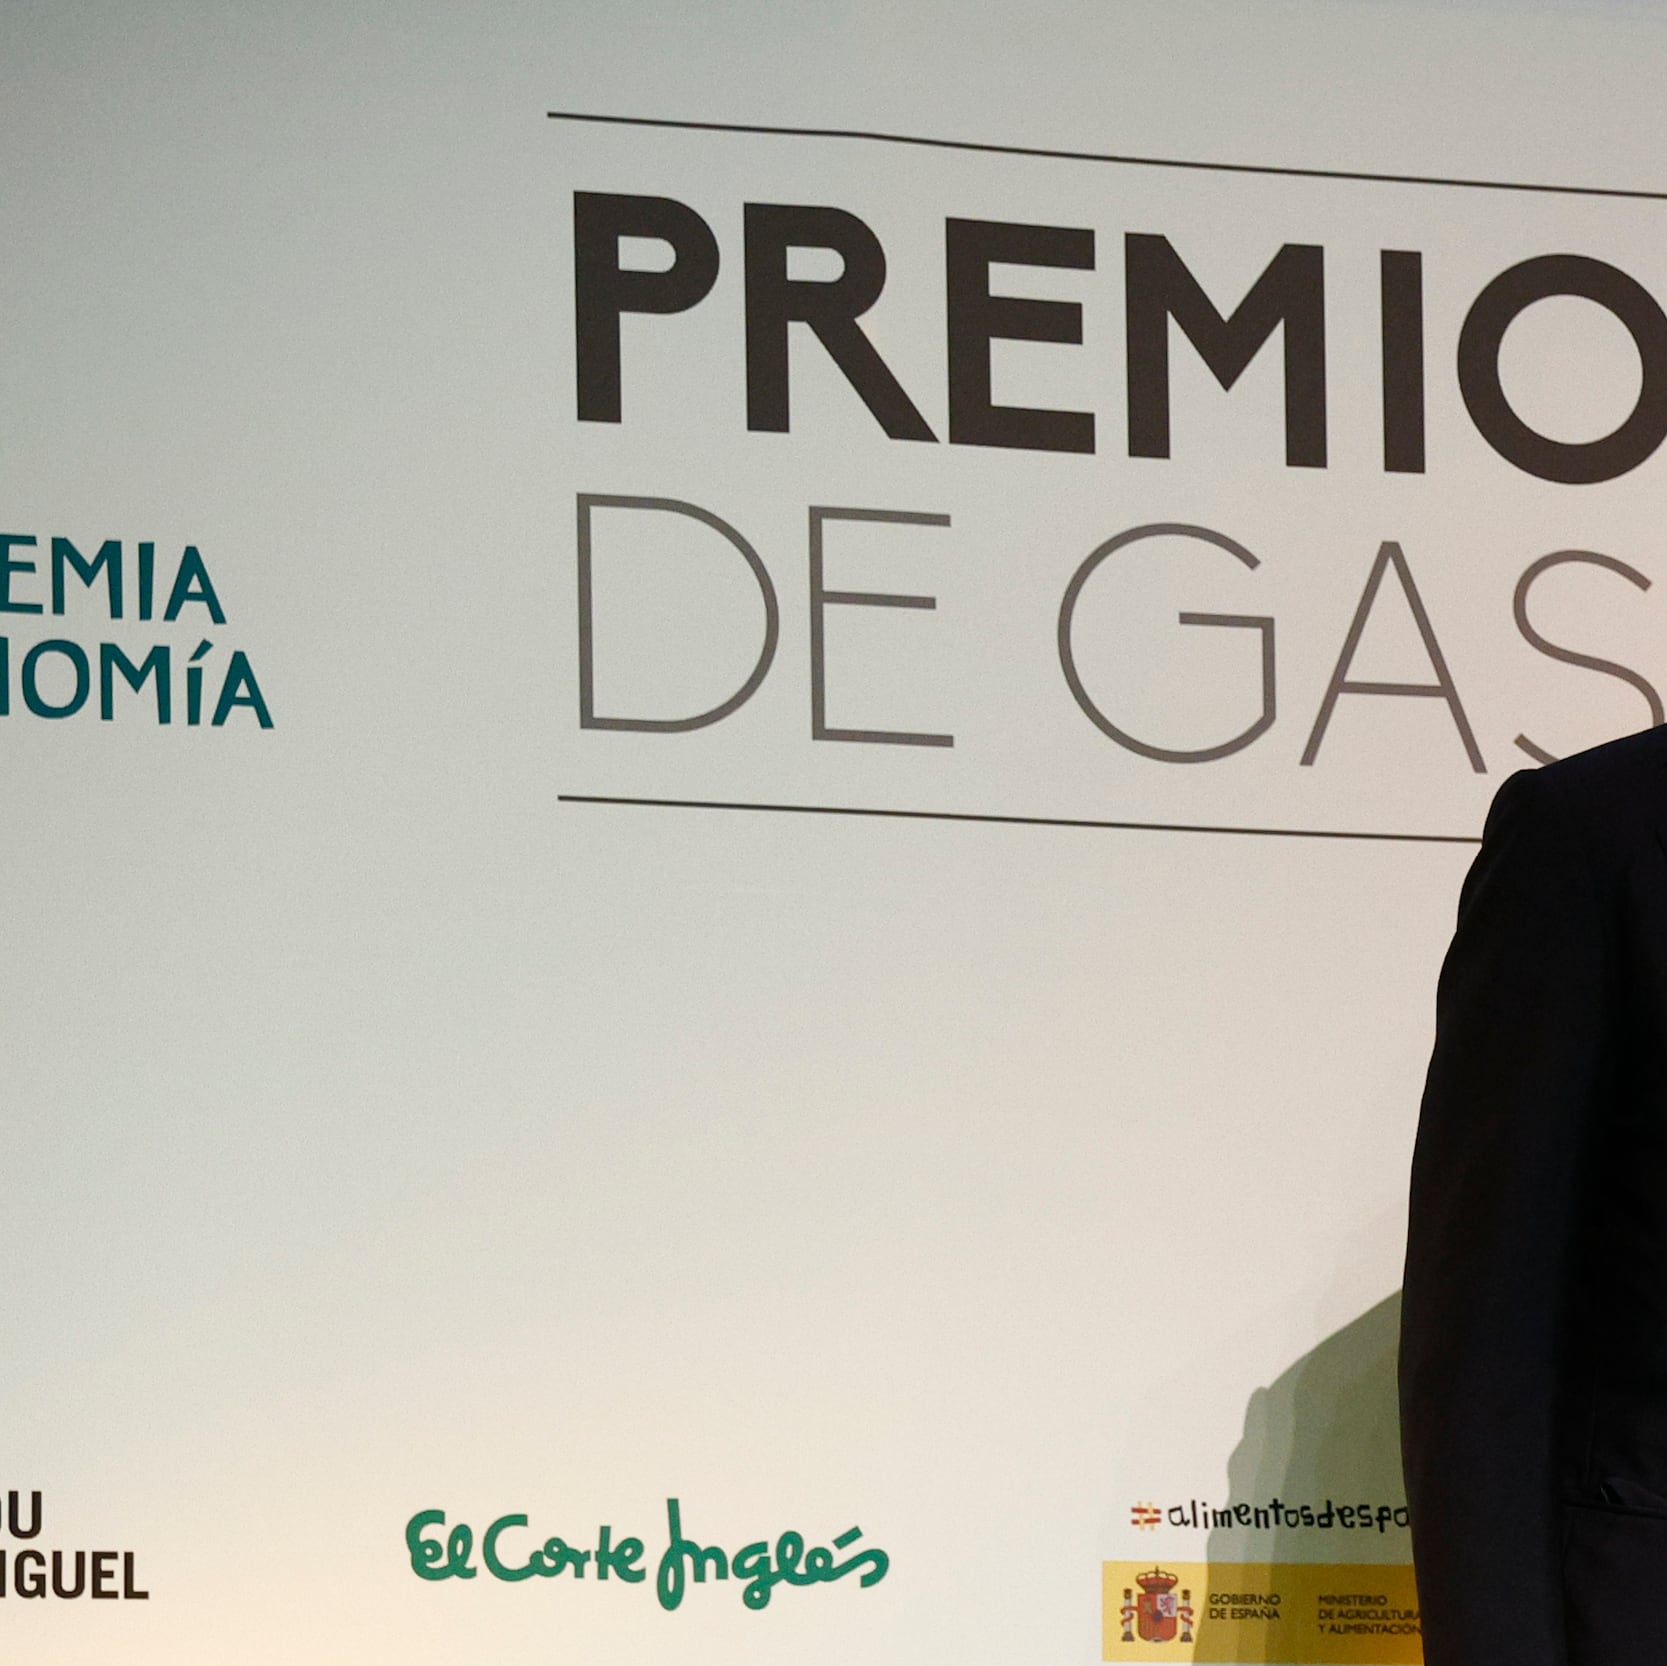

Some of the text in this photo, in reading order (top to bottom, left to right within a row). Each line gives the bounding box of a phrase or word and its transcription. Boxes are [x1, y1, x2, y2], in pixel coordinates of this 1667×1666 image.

[0, 533, 227, 624] EMIA
[576, 493, 954, 748] DE
[1131, 1498, 1411, 1532] #alimentosdespa
[405, 1498, 890, 1611] El Corte Inglés
[0, 1549, 149, 1600] IGUEL
[1208, 1593, 1282, 1606] GOBIERNO
[1318, 1595, 1388, 1606] MINISTERIO
[1209, 1605, 1281, 1619] DE ESPAÑA
[1318, 1609, 1334, 1620] DE
[1318, 1624, 1326, 1634] Y
